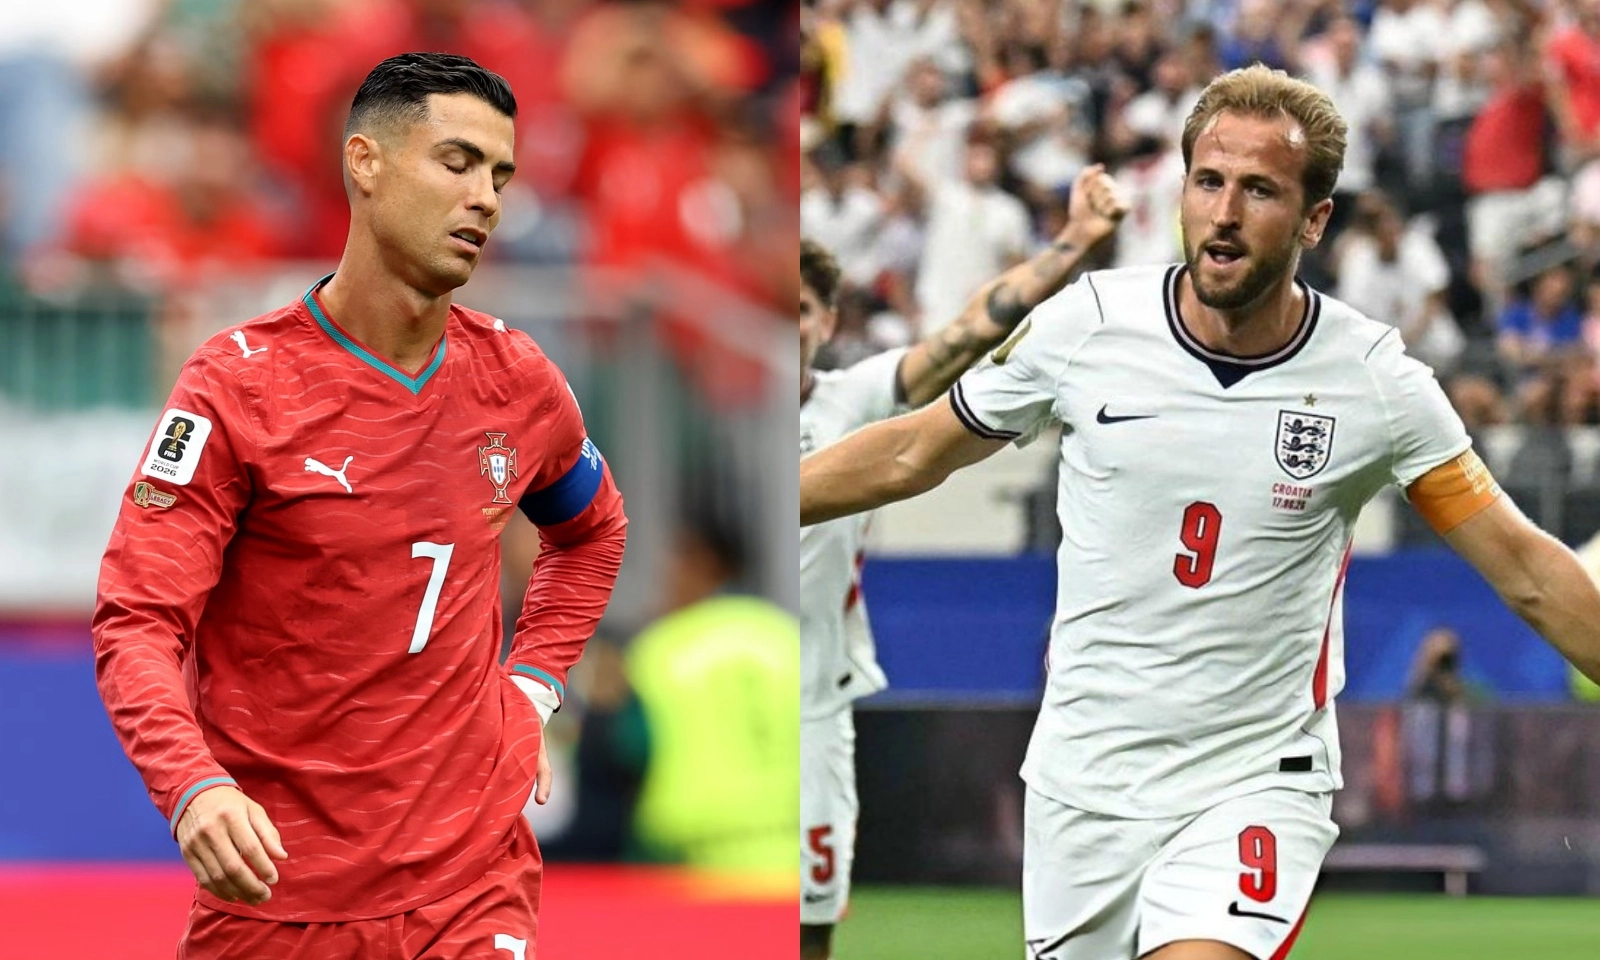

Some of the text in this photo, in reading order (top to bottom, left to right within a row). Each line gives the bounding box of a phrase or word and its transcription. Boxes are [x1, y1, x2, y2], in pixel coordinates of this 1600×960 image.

[150, 463, 177, 476] 2026
[153, 459, 170, 467] WORLD
[164, 450, 177, 458] FIFA
[1272, 483, 1312, 498] CROATIA
[1173, 501, 1222, 589] 9
[408, 541, 455, 654] 7
[807, 825, 835, 884] 5
[1238, 825, 1277, 903] 9
